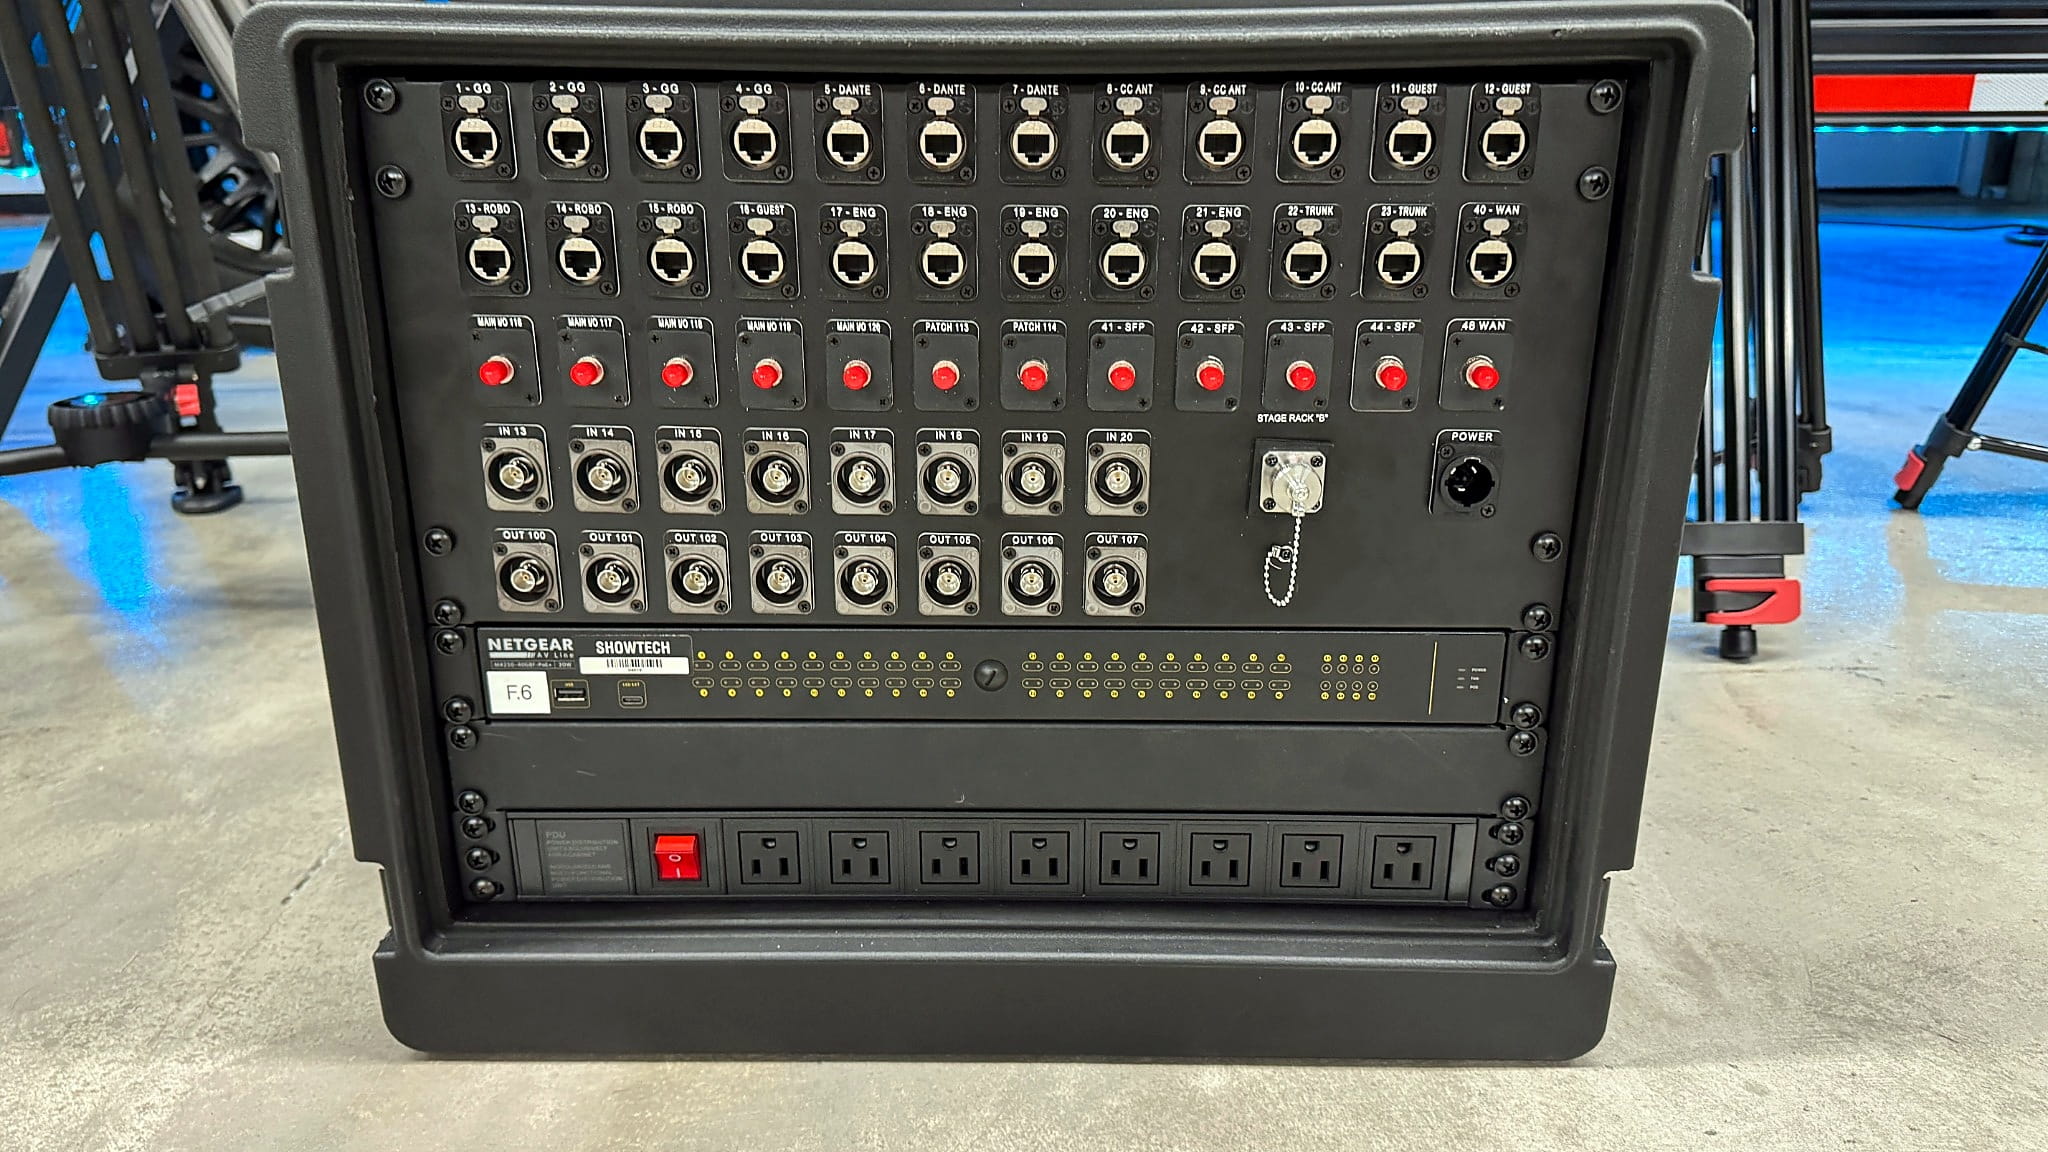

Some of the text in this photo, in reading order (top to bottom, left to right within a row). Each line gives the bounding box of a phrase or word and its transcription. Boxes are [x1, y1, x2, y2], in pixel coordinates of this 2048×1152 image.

[456, 83, 461, 94] 1
[473, 83, 492, 94] GG
[549, 81, 557, 93] 2
[567, 81, 586, 93] GG
[642, 83, 648, 94] 3
[660, 83, 679, 94] GG
[736, 83, 742, 95] 4
[753, 83, 772, 95] GG
[824, 84, 830, 95] 5
[838, 84, 871, 95] DANTE
[933, 84, 966, 95] DANTE
[1013, 84, 1019, 95] 7
[1027, 84, 1059, 95] DANTE
[1120, 84, 1133, 95] CC
[1135, 84, 1153, 95] ANT
[1213, 84, 1226, 95] CC
[1228, 84, 1247, 95] ANT
[1295, 81, 1304, 93] 10
[1311, 81, 1324, 93] CC
[1325, 81, 1342, 93] ANT
[1391, 83, 1401, 95] 11
[1408, 83, 1437, 95] GUEST
[1485, 83, 1494, 95] 12
[1501, 83, 1531, 95] GUEST
[465, 203, 476, 215] 13
[483, 203, 511, 215] ROBO
[556, 203, 567, 215] 14
[574, 203, 602, 215] ROBO
[667, 203, 694, 215] ROBO
[756, 204, 785, 215] GUEST
[831, 207, 842, 218] 17
[853, 207, 876, 218] ENG
[944, 206, 967, 217] ENG
[1035, 207, 1059, 218] ENG
[1104, 208, 1116, 218] 20
[1126, 208, 1149, 218] ENG
[1196, 207, 1208, 218] 21
[1218, 207, 1242, 218] ENG
[1287, 205, 1298, 216] 22
[1305, 205, 1334, 216] TRUNK
[1381, 206, 1392, 217] 23
[1398, 206, 1427, 217] TRUNK
[1473, 205, 1486, 215] 40
[1495, 205, 1520, 215] WAN
[477, 316, 499, 328] MAIN
[567, 317, 589, 328] MAIN
[601, 317, 612, 328] 117
[658, 318, 678, 329] MAIN
[747, 320, 767, 332] MAIN
[837, 321, 856, 333] MAIN
[925, 322, 969, 332] PATCH 113
[1013, 321, 1057, 332] PATCH 114
[1101, 323, 1114, 332] 41
[1124, 323, 1145, 332] SFP
[1280, 322, 1294, 332] 43
[1304, 322, 1325, 332] SFP
[1370, 322, 1383, 332] 44
[1394, 322, 1416, 332] SFP
[1478, 321, 1506, 331] WAN
[1190, 324, 1203, 334] 42
[1214, 324, 1235, 334] SFP
[1257, 413, 1329, 423] STAGE RACK "B"
[498, 426, 527, 436] IN 13
[586, 427, 614, 437] IN 14
[674, 429, 685, 439] IN
[762, 431, 773, 441] IN
[849, 429, 876, 440] IN 17
[935, 431, 946, 441] IN
[1021, 432, 1032, 442] IN
[1106, 432, 1133, 442] IN 20
[1451, 432, 1493, 442] POWER
[503, 531, 546, 541] OUT 100
[589, 532, 633, 542] OUT 101
[674, 533, 717, 543] OUT 102
[760, 533, 802, 542] OUT 103
[845, 534, 887, 544] OUT 104
[929, 534, 971, 545] OUT 105
[1012, 535, 1033, 545] OUT
[1097, 535, 1138, 545] OUT 107
[488, 638, 574, 651] NETGEAR
[595, 640, 671, 655] SHOWTECH
[506, 684, 532, 700] F.6
